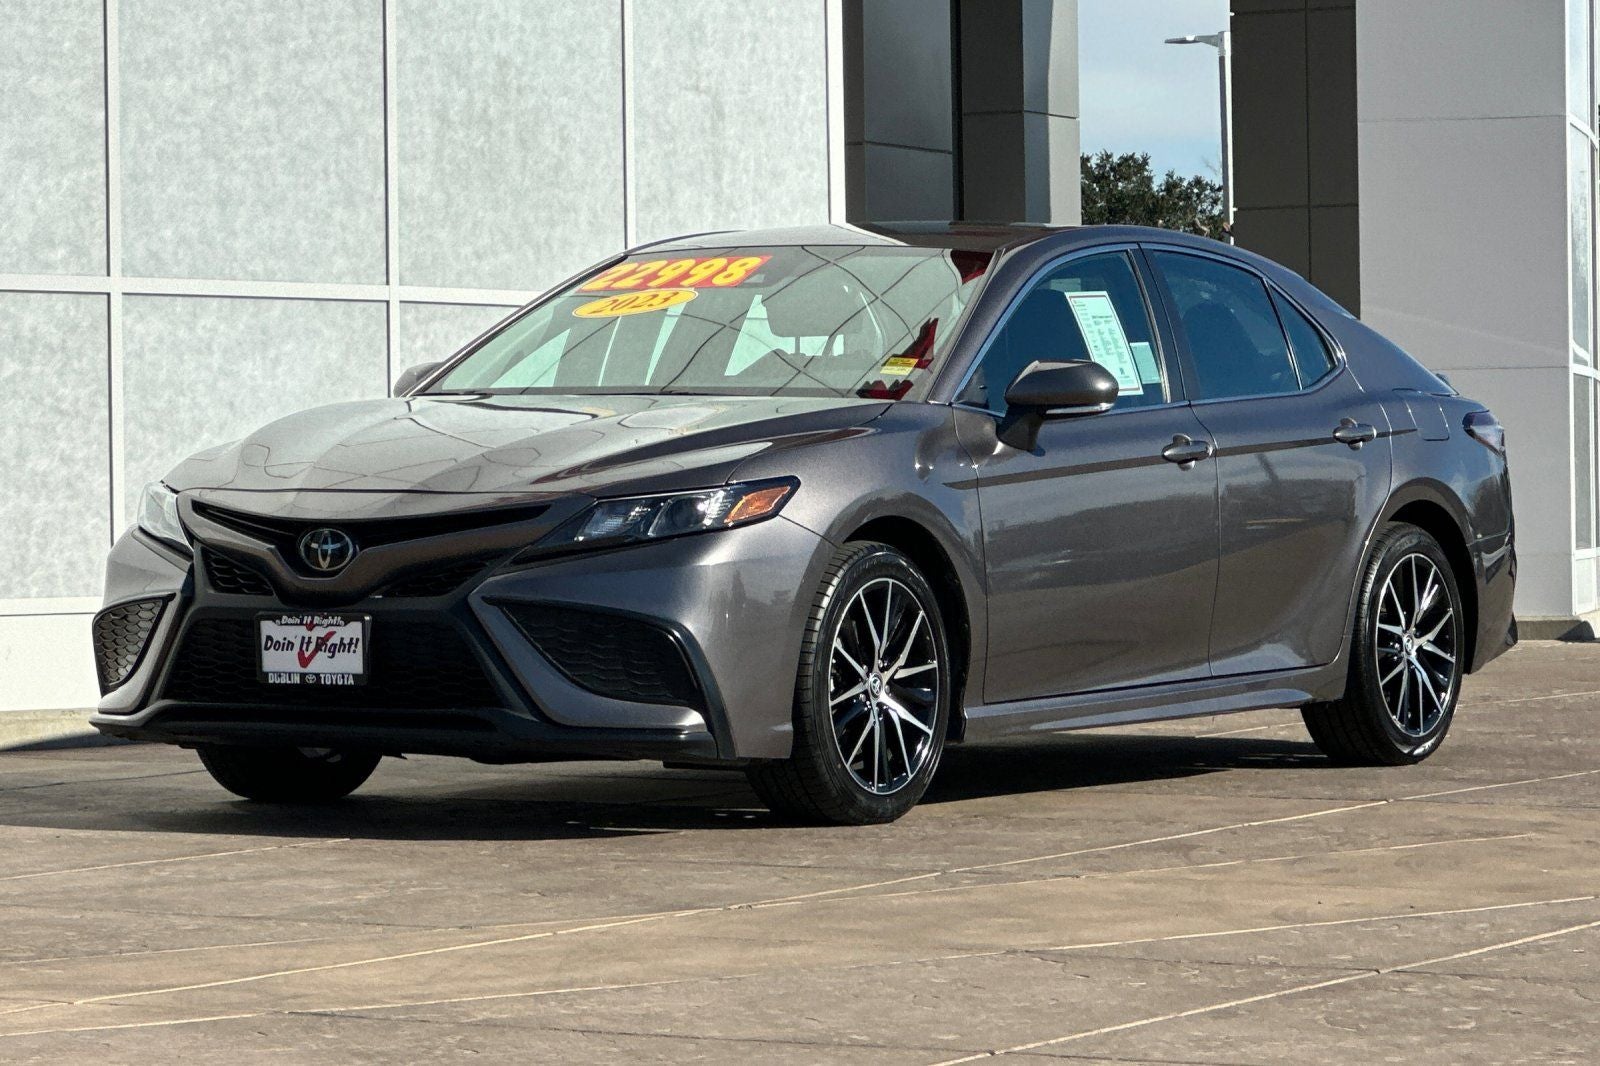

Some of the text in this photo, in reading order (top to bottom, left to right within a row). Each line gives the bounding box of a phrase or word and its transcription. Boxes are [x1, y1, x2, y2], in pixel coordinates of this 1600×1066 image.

[581, 257, 762, 290] 22998
[588, 291, 680, 315] 2023
[303, 616, 312, 624] It
[264, 635, 360, 659] Doin' It Right!
[268, 673, 355, 685] DUBLIN TOYOTA
